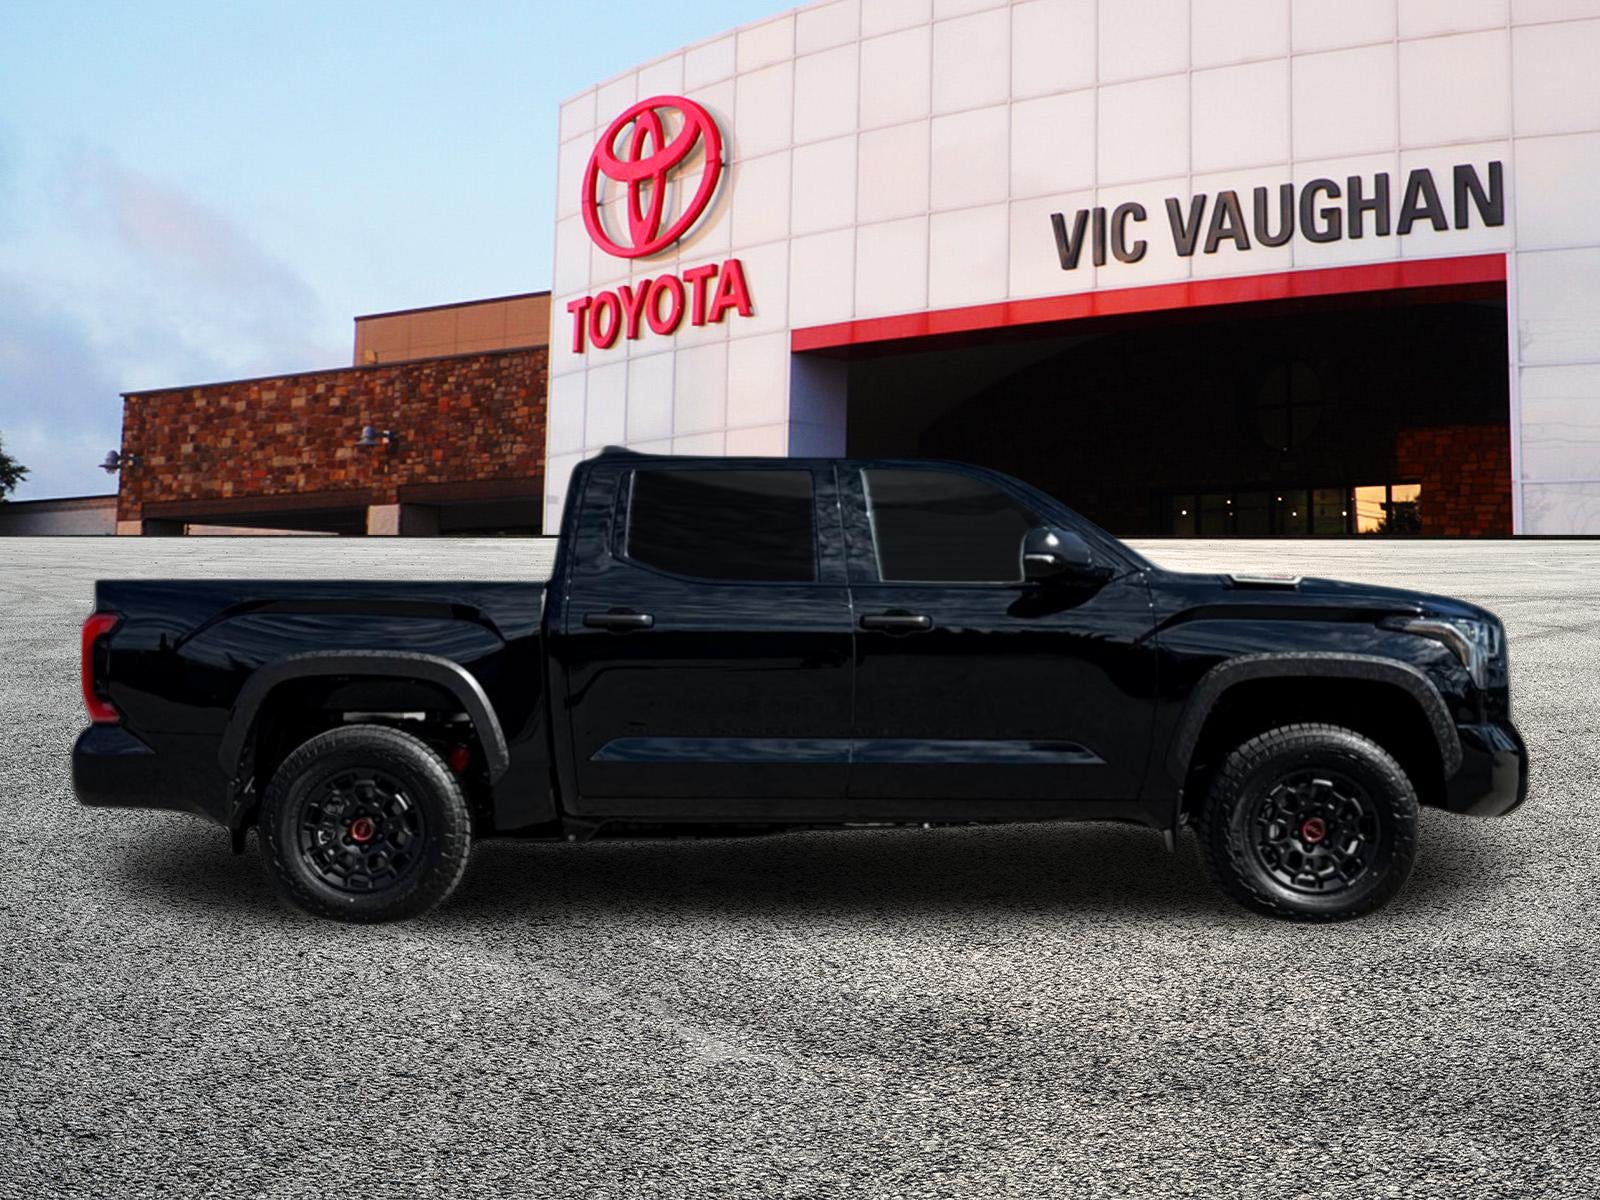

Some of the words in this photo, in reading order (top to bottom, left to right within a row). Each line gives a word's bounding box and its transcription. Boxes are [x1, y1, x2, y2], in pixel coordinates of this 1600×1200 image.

[1050, 201, 1148, 271] VIC
[1164, 160, 1505, 257] VAUGHAN
[567, 258, 754, 353] TOYOTA
